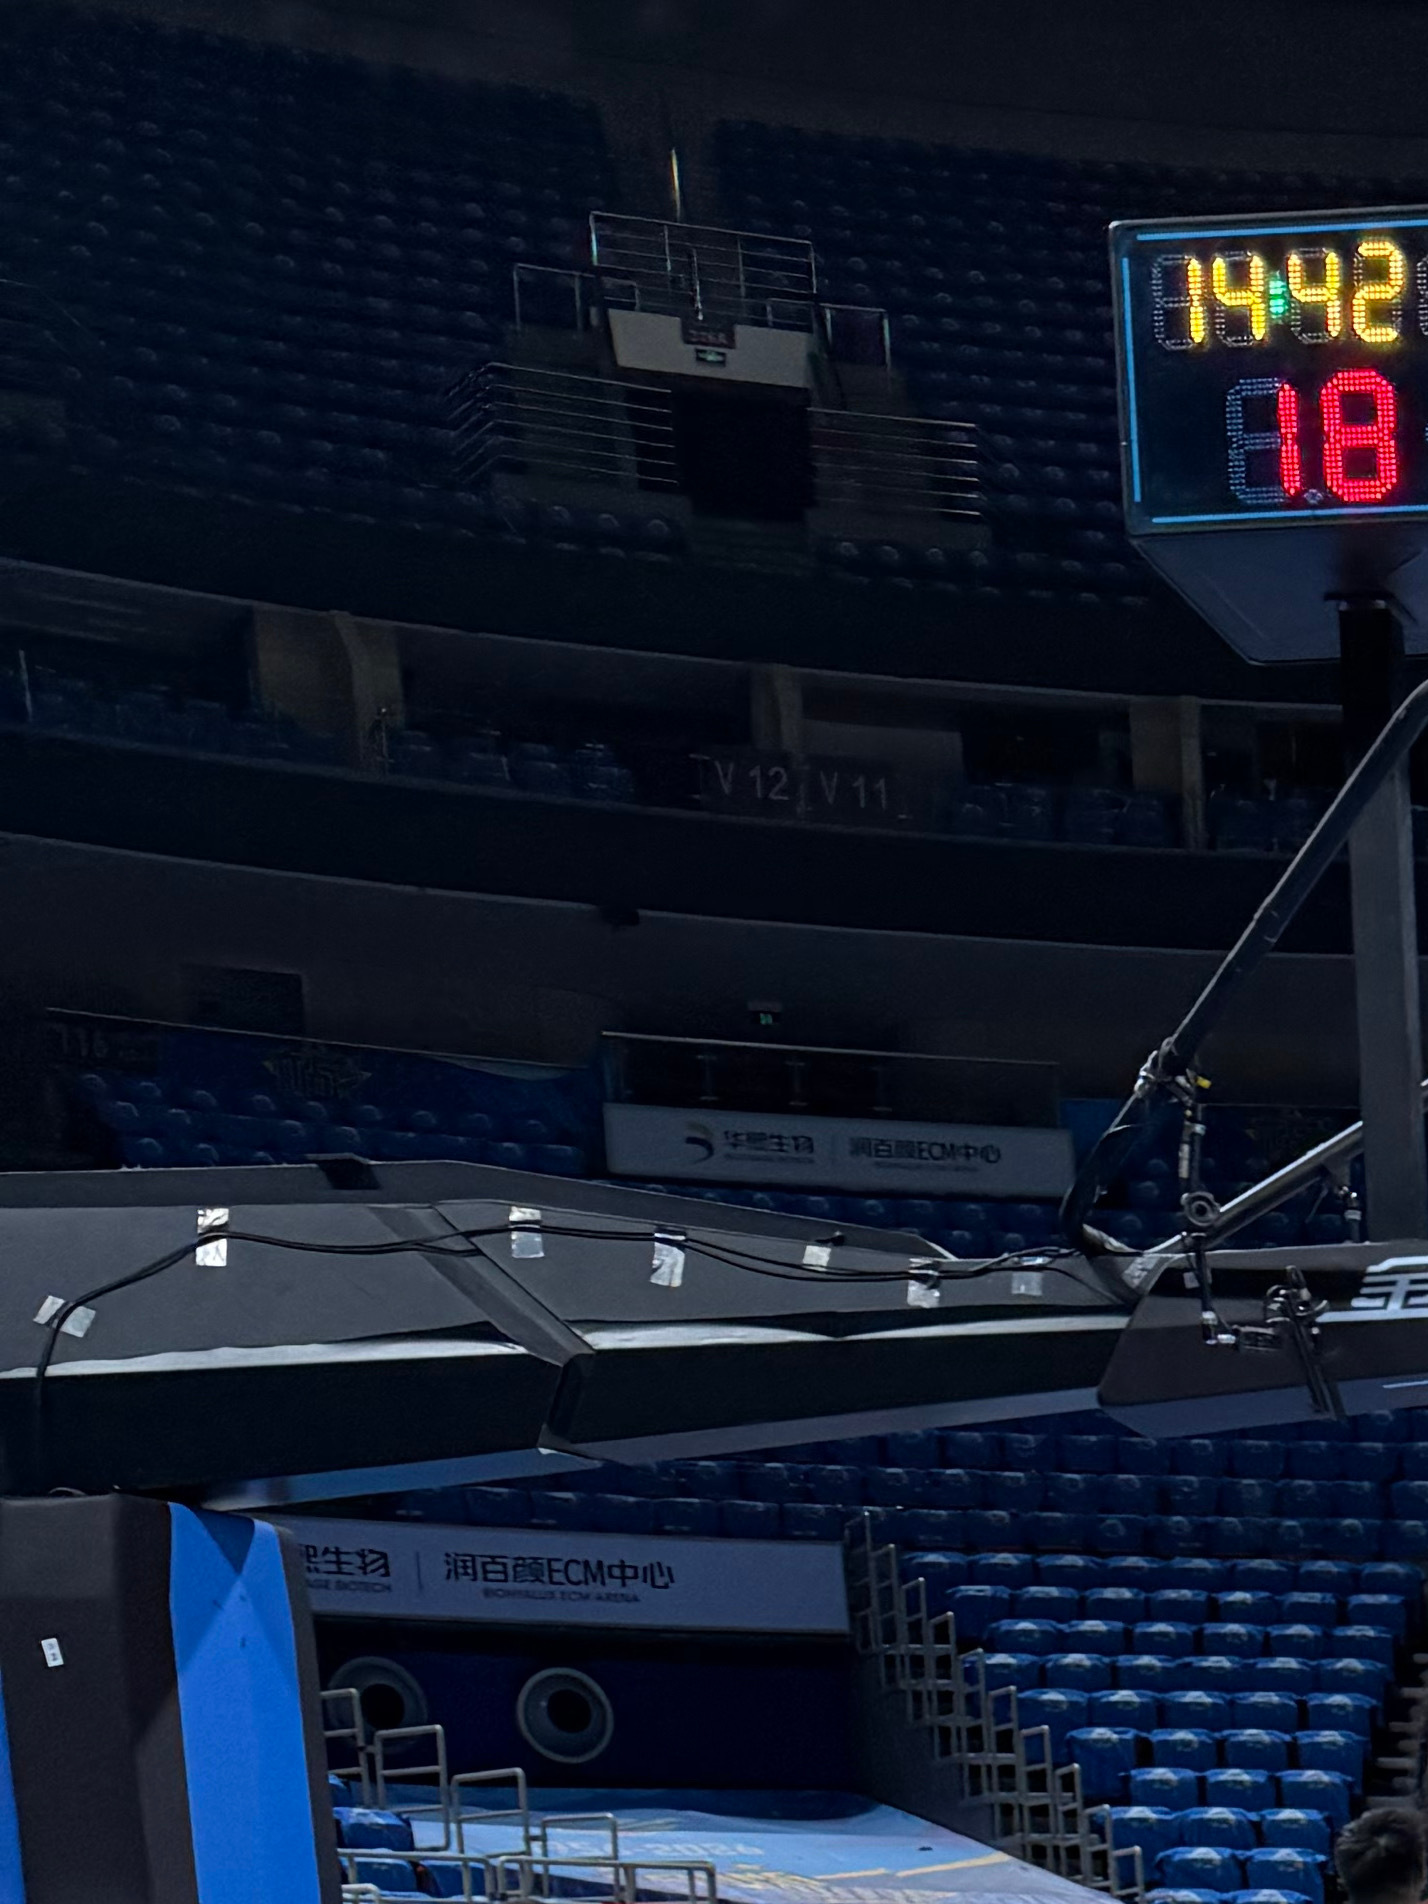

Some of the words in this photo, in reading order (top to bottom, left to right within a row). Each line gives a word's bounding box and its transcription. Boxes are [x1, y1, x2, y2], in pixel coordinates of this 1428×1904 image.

[714, 760, 735, 796] V
[750, 764, 789, 801] 12
[820, 770, 838, 805] V
[852, 774, 887, 810] 11
[444, 1551, 674, 1590] 润百颜ECM中心
